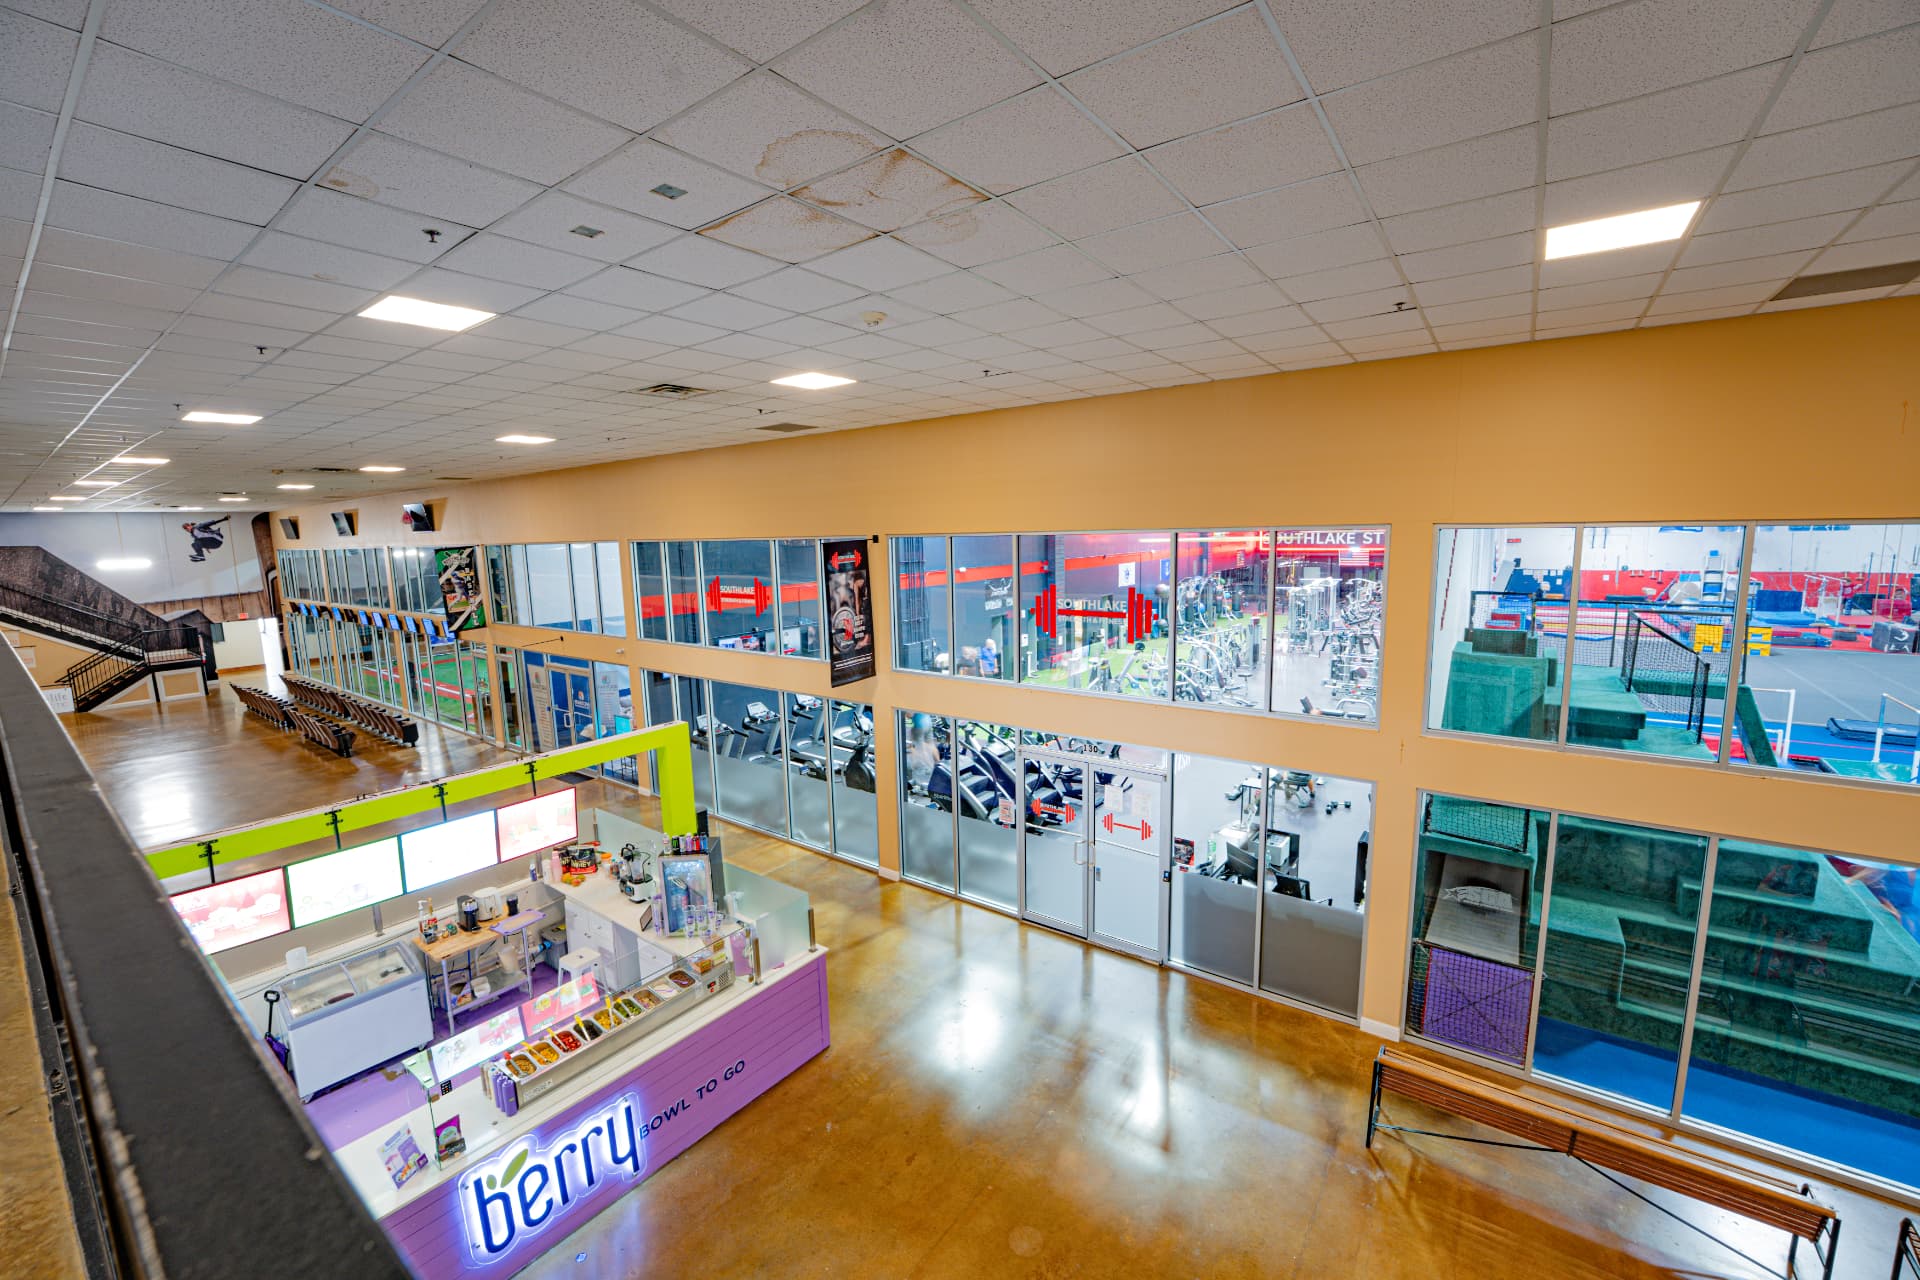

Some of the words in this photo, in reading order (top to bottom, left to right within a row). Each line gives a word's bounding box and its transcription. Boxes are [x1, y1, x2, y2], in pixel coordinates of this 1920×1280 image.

[1362, 532, 1385, 544] ST
[1083, 744, 1098, 753] 130
[639, 1098, 691, 1140] BOWL
[695, 1078, 718, 1099] TO
[723, 1060, 745, 1081] GO
[473, 1105, 640, 1254] berry
